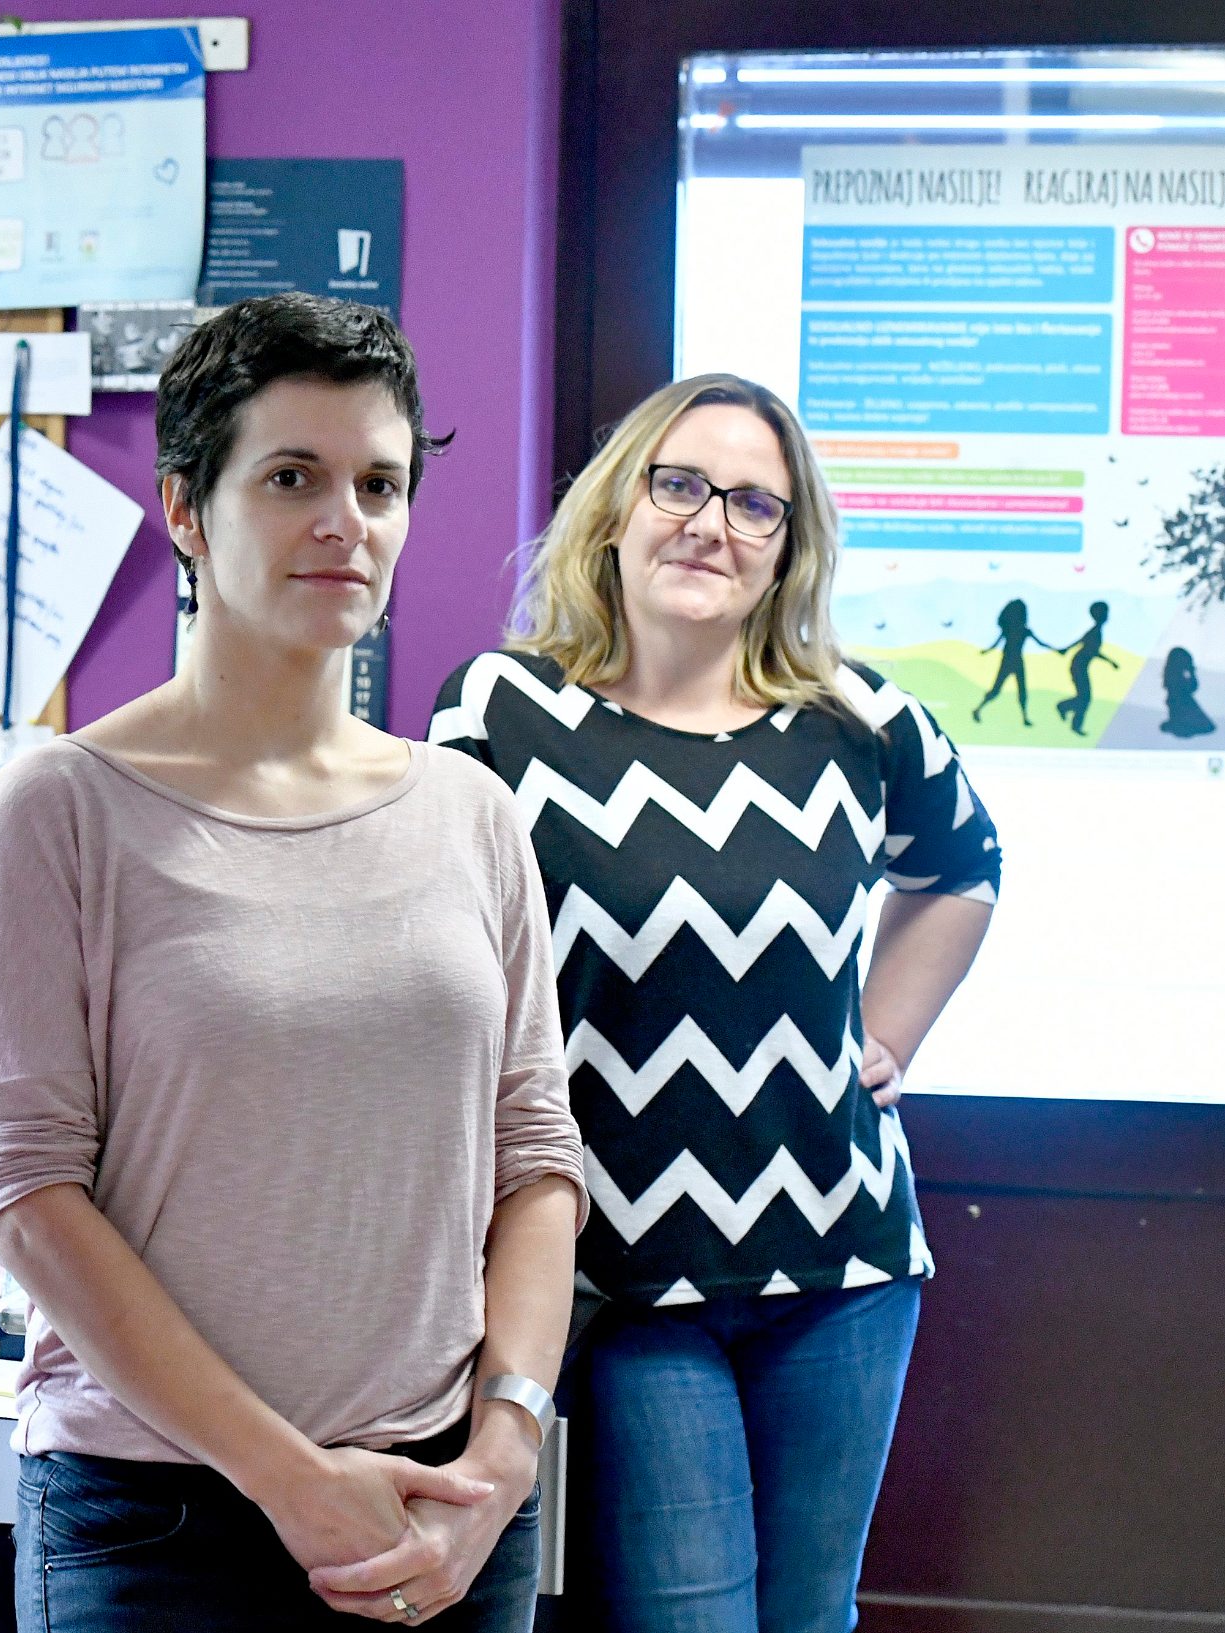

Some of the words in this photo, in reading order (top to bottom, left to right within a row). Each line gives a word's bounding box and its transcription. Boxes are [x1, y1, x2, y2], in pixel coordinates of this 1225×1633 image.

[813, 168, 914, 208] PREPOZNAJ
[919, 168, 1002, 207] NASILJE!
[1025, 168, 1119, 209] REAGIRAJ
[1125, 169, 1152, 205] NA
